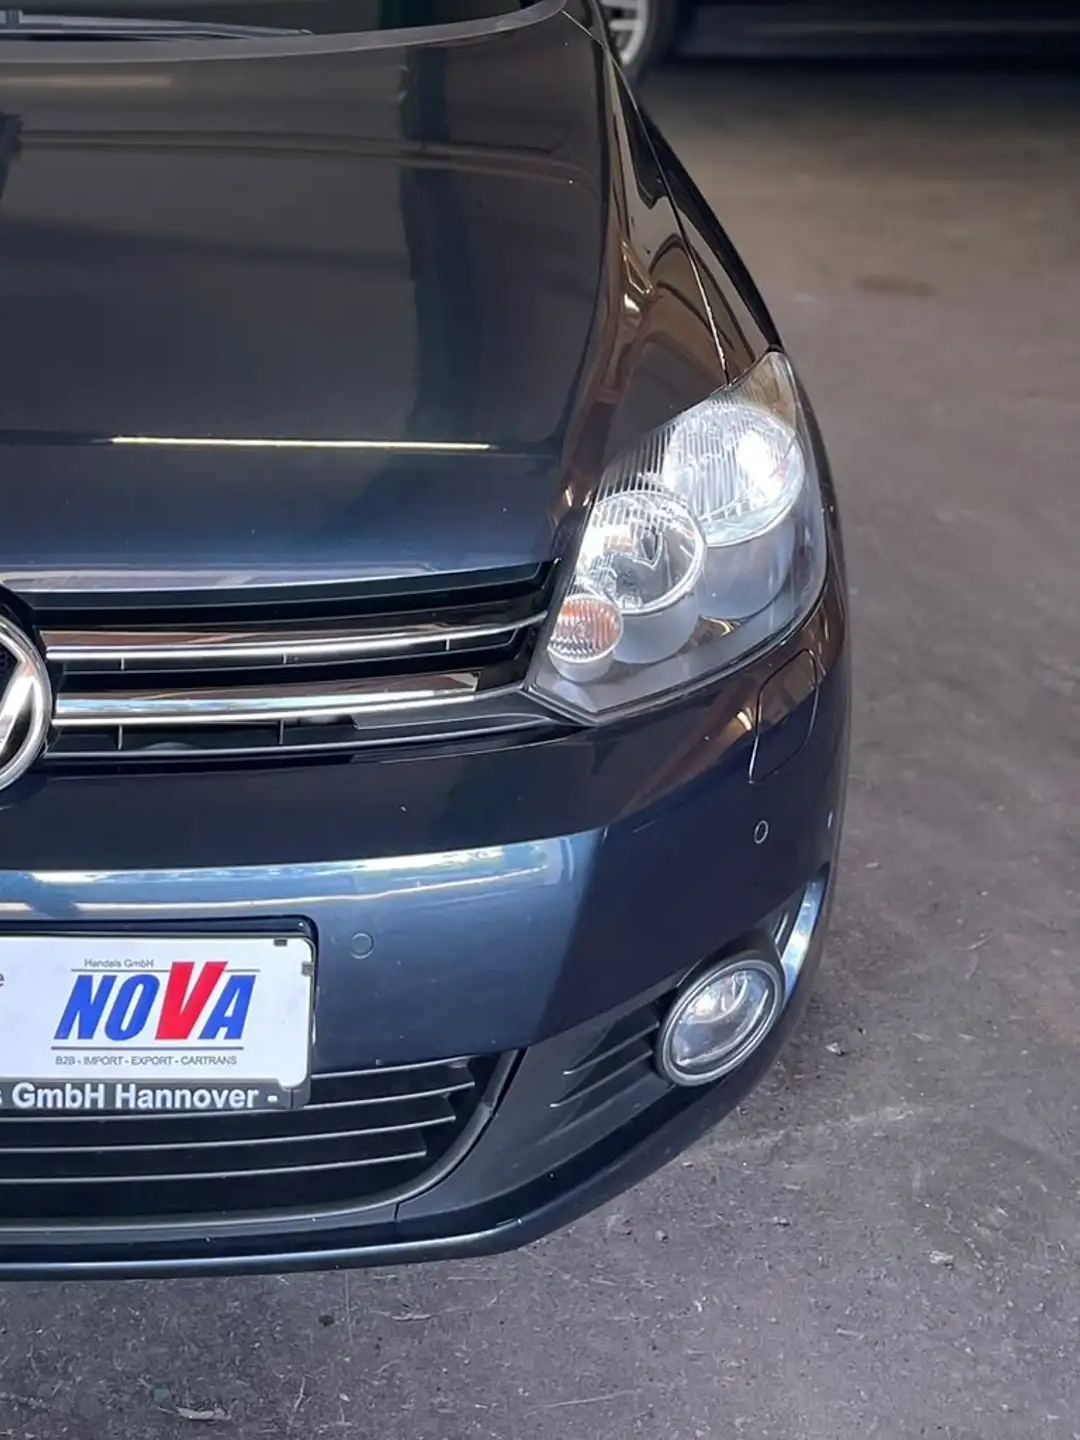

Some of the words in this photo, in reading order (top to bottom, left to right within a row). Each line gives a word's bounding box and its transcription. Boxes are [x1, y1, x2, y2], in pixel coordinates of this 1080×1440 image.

[84, 958, 122, 968] Handels
[124, 958, 154, 968] GmbH
[53, 961, 257, 1041] NOVA
[55, 1056, 76, 1066] B2B
[83, 1056, 124, 1066] IMPORT
[131, 1056, 173, 1066] EXPORT
[181, 1056, 237, 1066] CARTRANS
[12, 1082, 104, 1109] GmbH
[115, 1083, 259, 1109] Hannover
